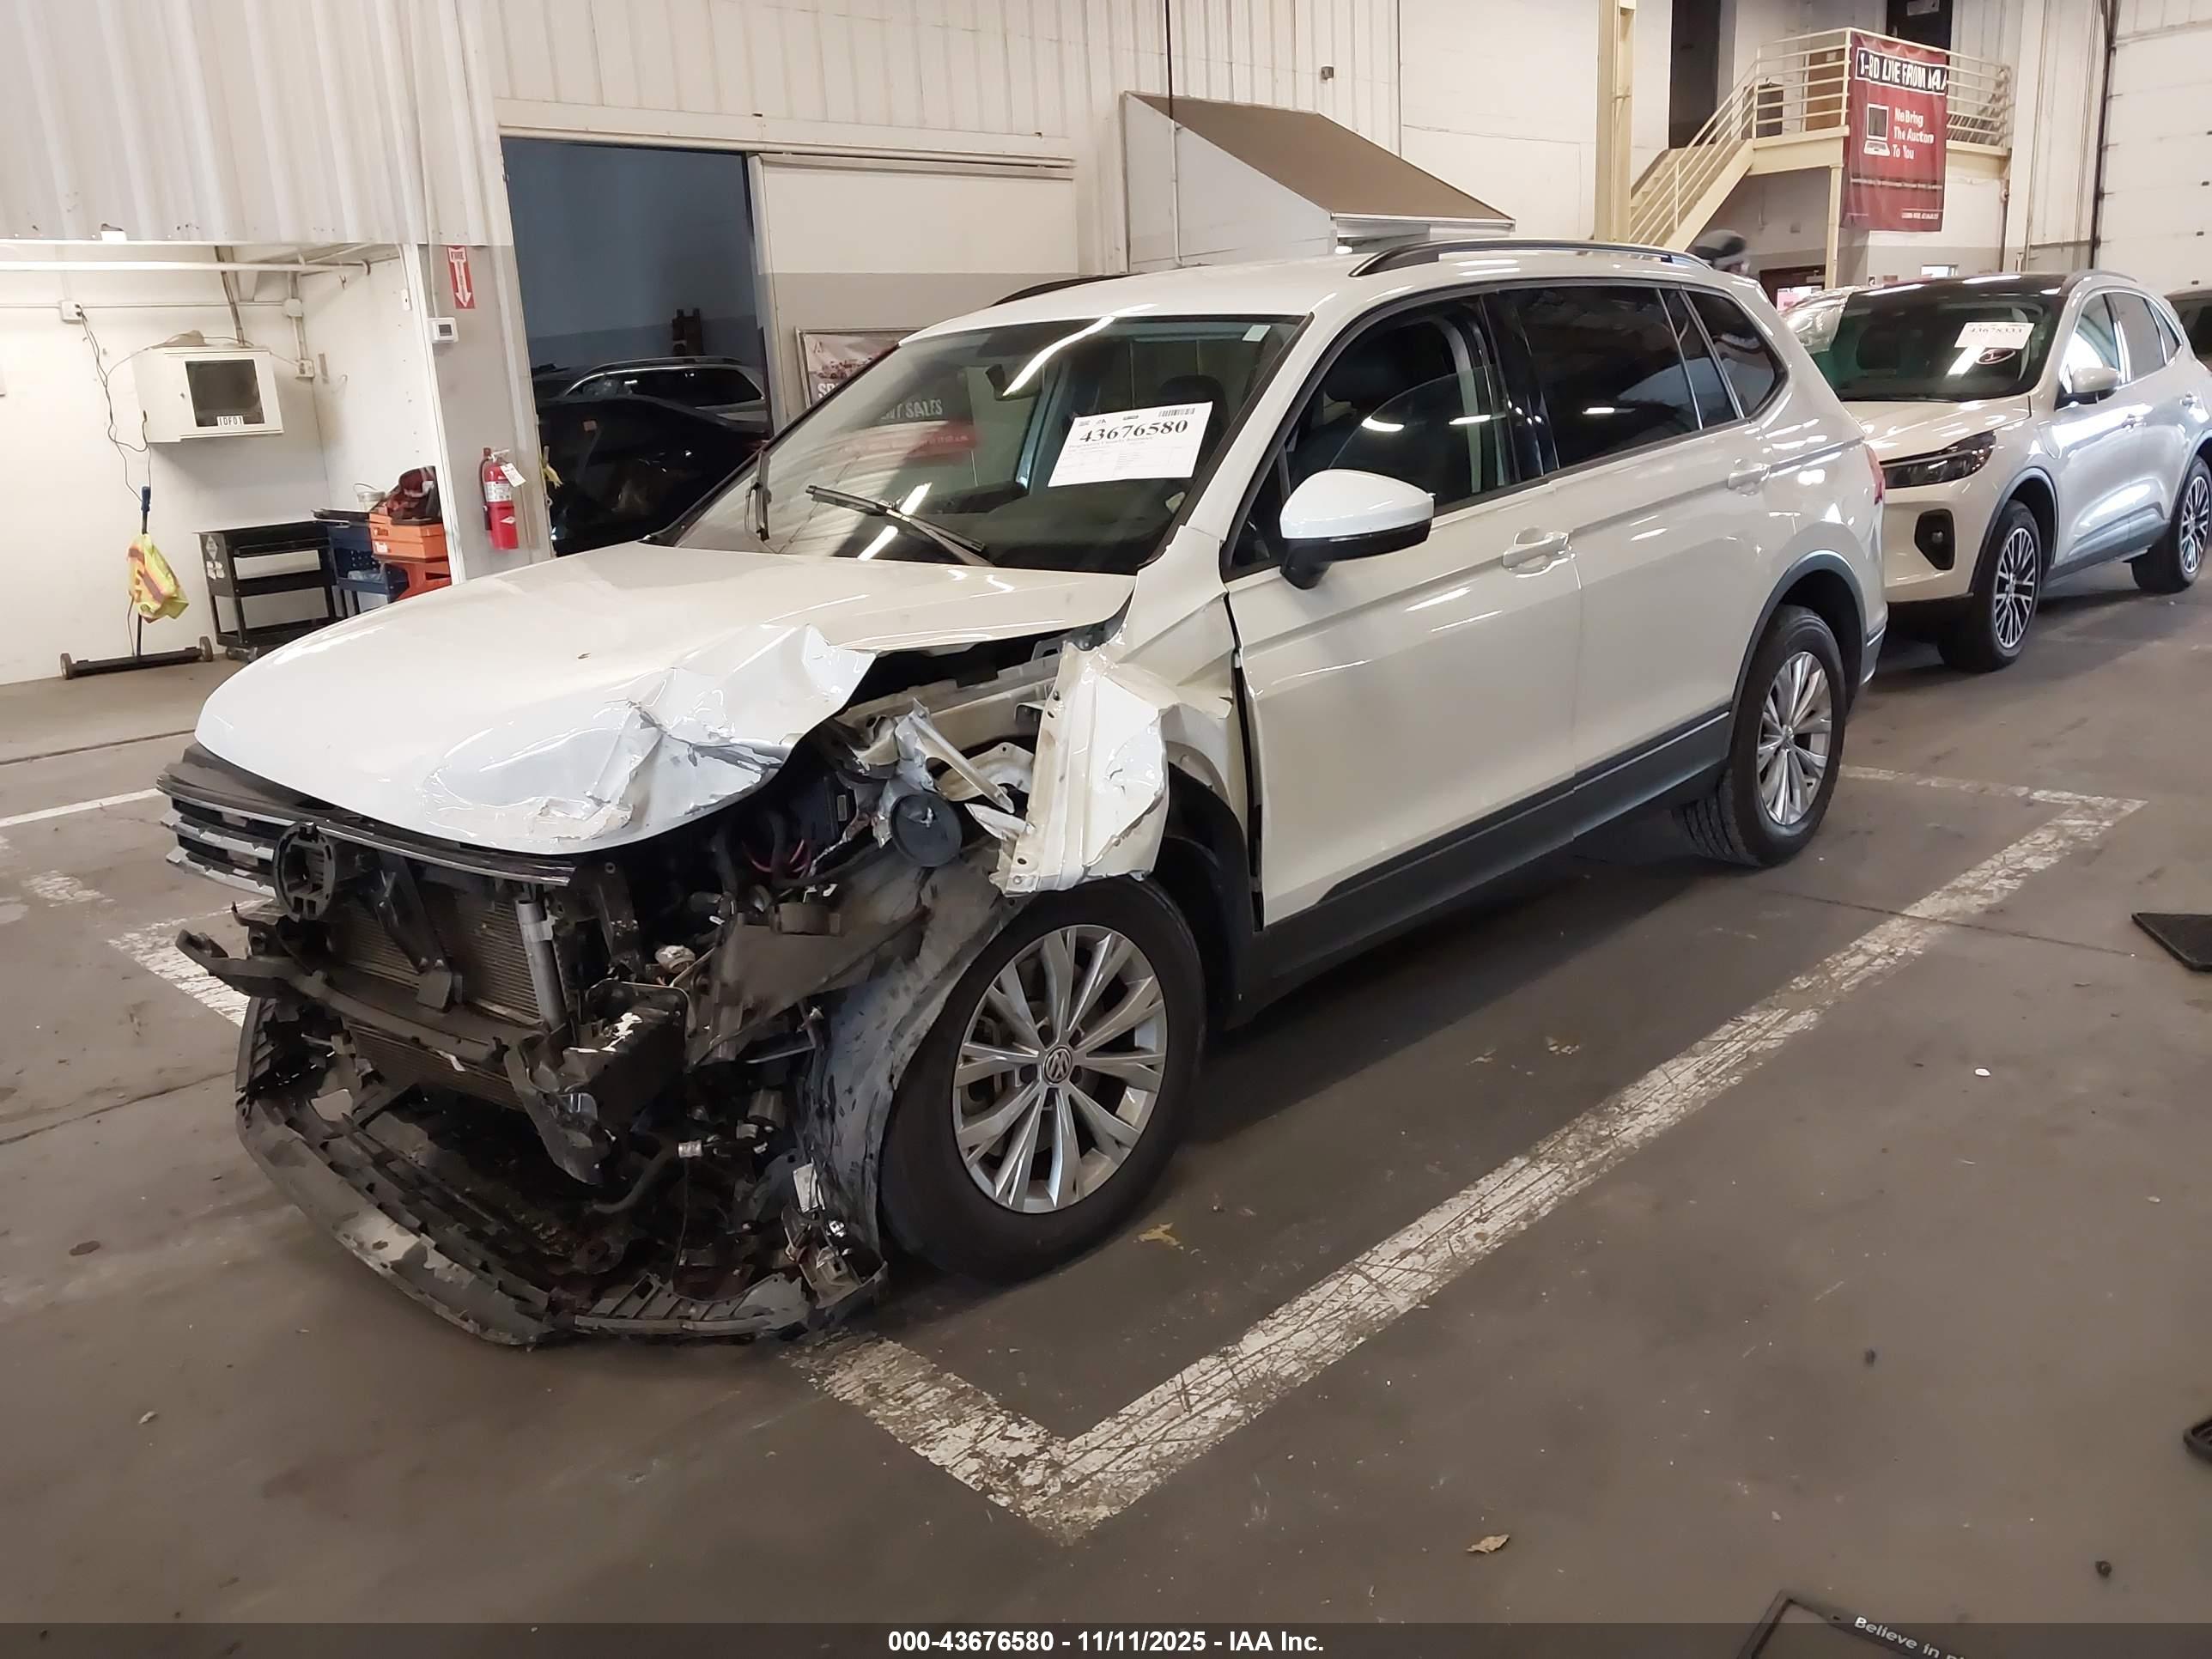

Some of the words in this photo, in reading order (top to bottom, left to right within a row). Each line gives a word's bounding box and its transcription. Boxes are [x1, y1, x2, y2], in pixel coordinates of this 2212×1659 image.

[1902, 62, 1926, 88] FROM
[1905, 109, 1923, 127] Bring
[1893, 126, 1905, 140] The
[1893, 144, 1900, 158] To
[1903, 145, 1914, 160] You
[906, 398, 943, 418] SALES
[1079, 419, 1188, 442] 43676580
[1855, 1616, 1917, 1649] Believe
[1923, 1643, 1940, 1658] in
